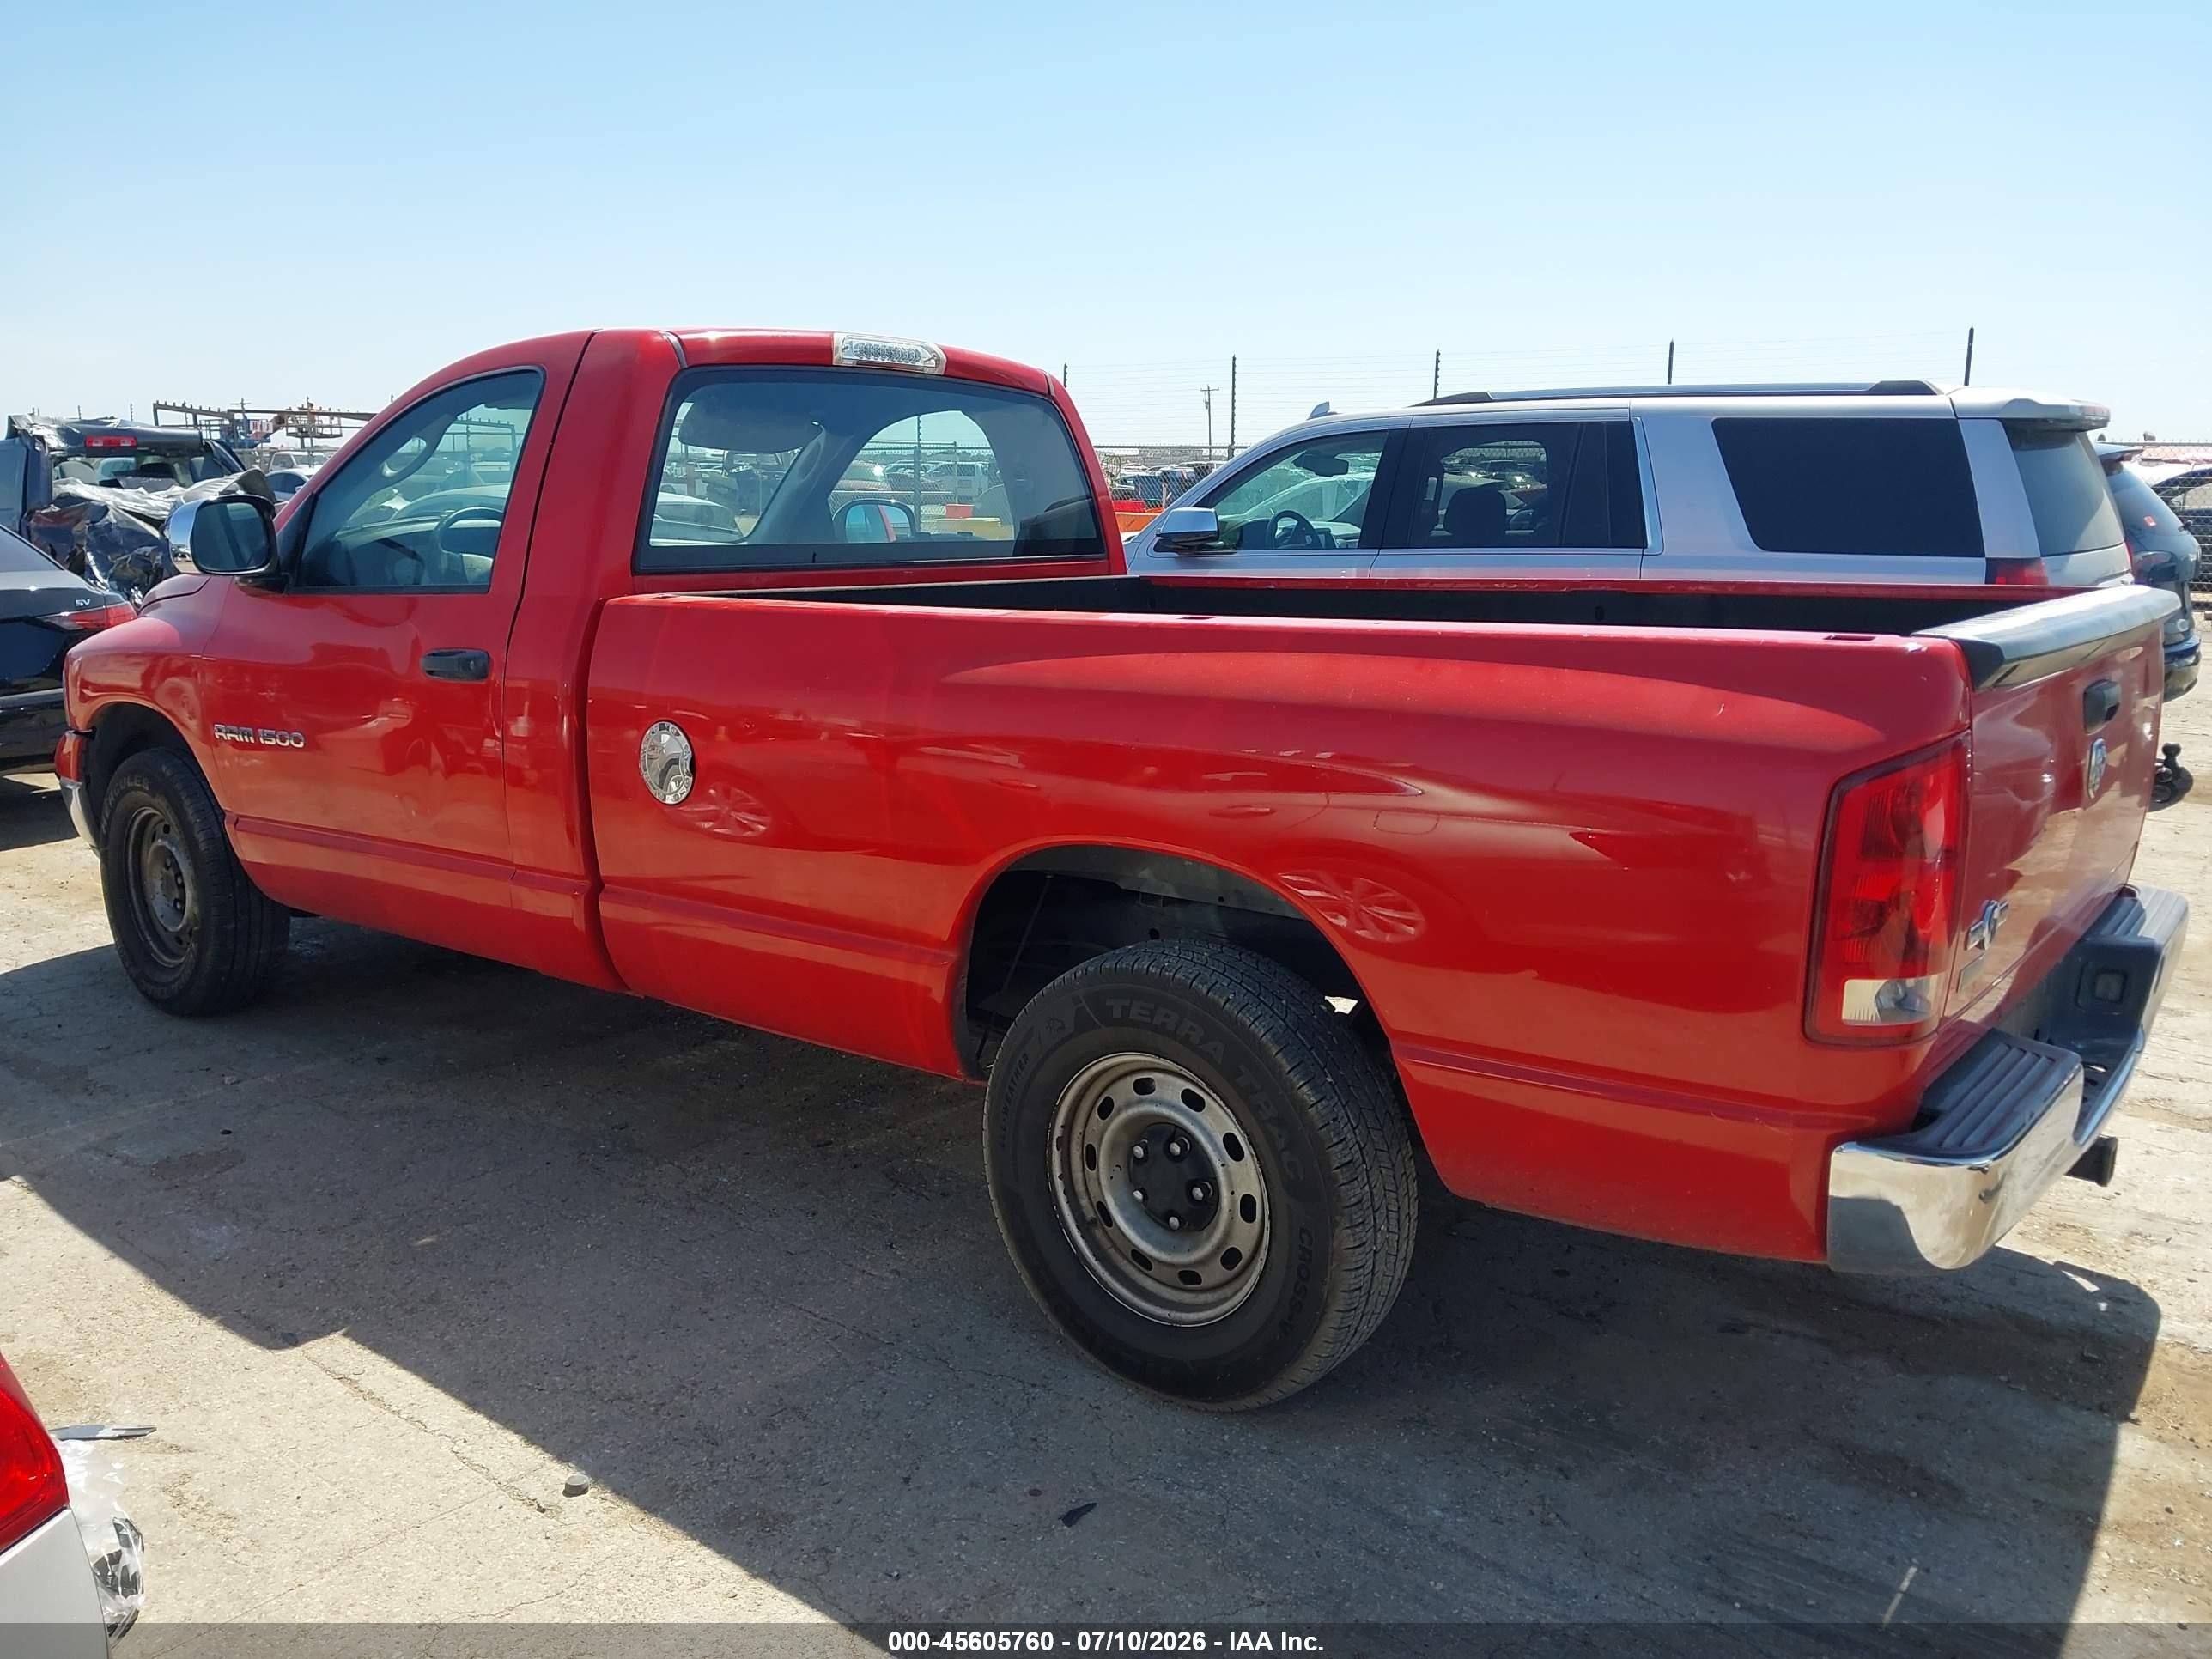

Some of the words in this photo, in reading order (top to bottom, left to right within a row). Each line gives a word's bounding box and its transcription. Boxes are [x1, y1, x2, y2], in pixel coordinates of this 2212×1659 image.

[214, 723, 255, 744] RAM
[258, 727, 305, 749] 1500
[1105, 997, 1226, 1066] TERRA
[1235, 1064, 1305, 1182] TRAC
